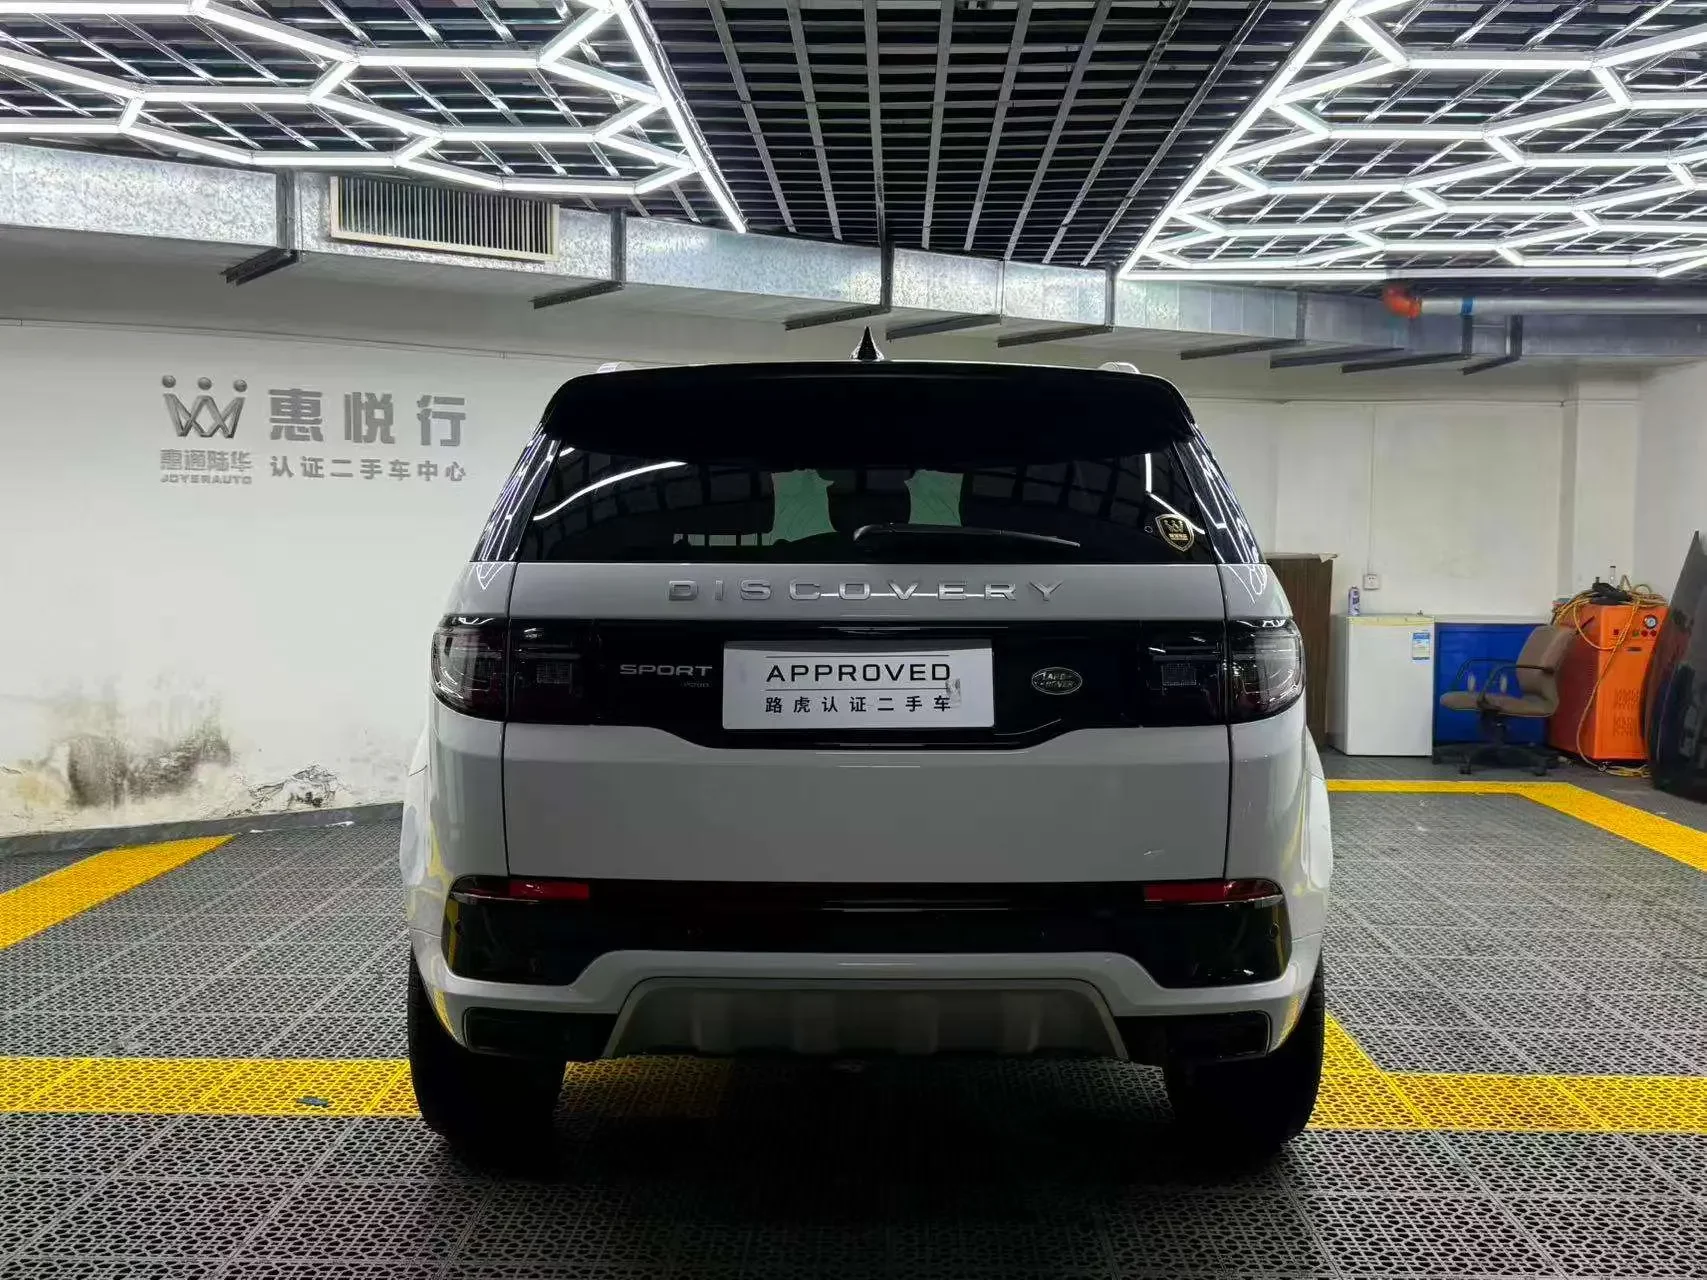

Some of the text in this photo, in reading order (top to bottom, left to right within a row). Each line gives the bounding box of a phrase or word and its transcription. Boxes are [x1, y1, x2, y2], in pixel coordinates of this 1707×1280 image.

[268, 388, 467, 447] 惠悦行
[270, 456, 467, 482] 认证二手车中心
[669, 579, 1062, 601] DISCOVERY
[619, 663, 713, 677] SPORT
[766, 663, 951, 682] APPROVED
[765, 696, 951, 714] 路虎认证二手车
